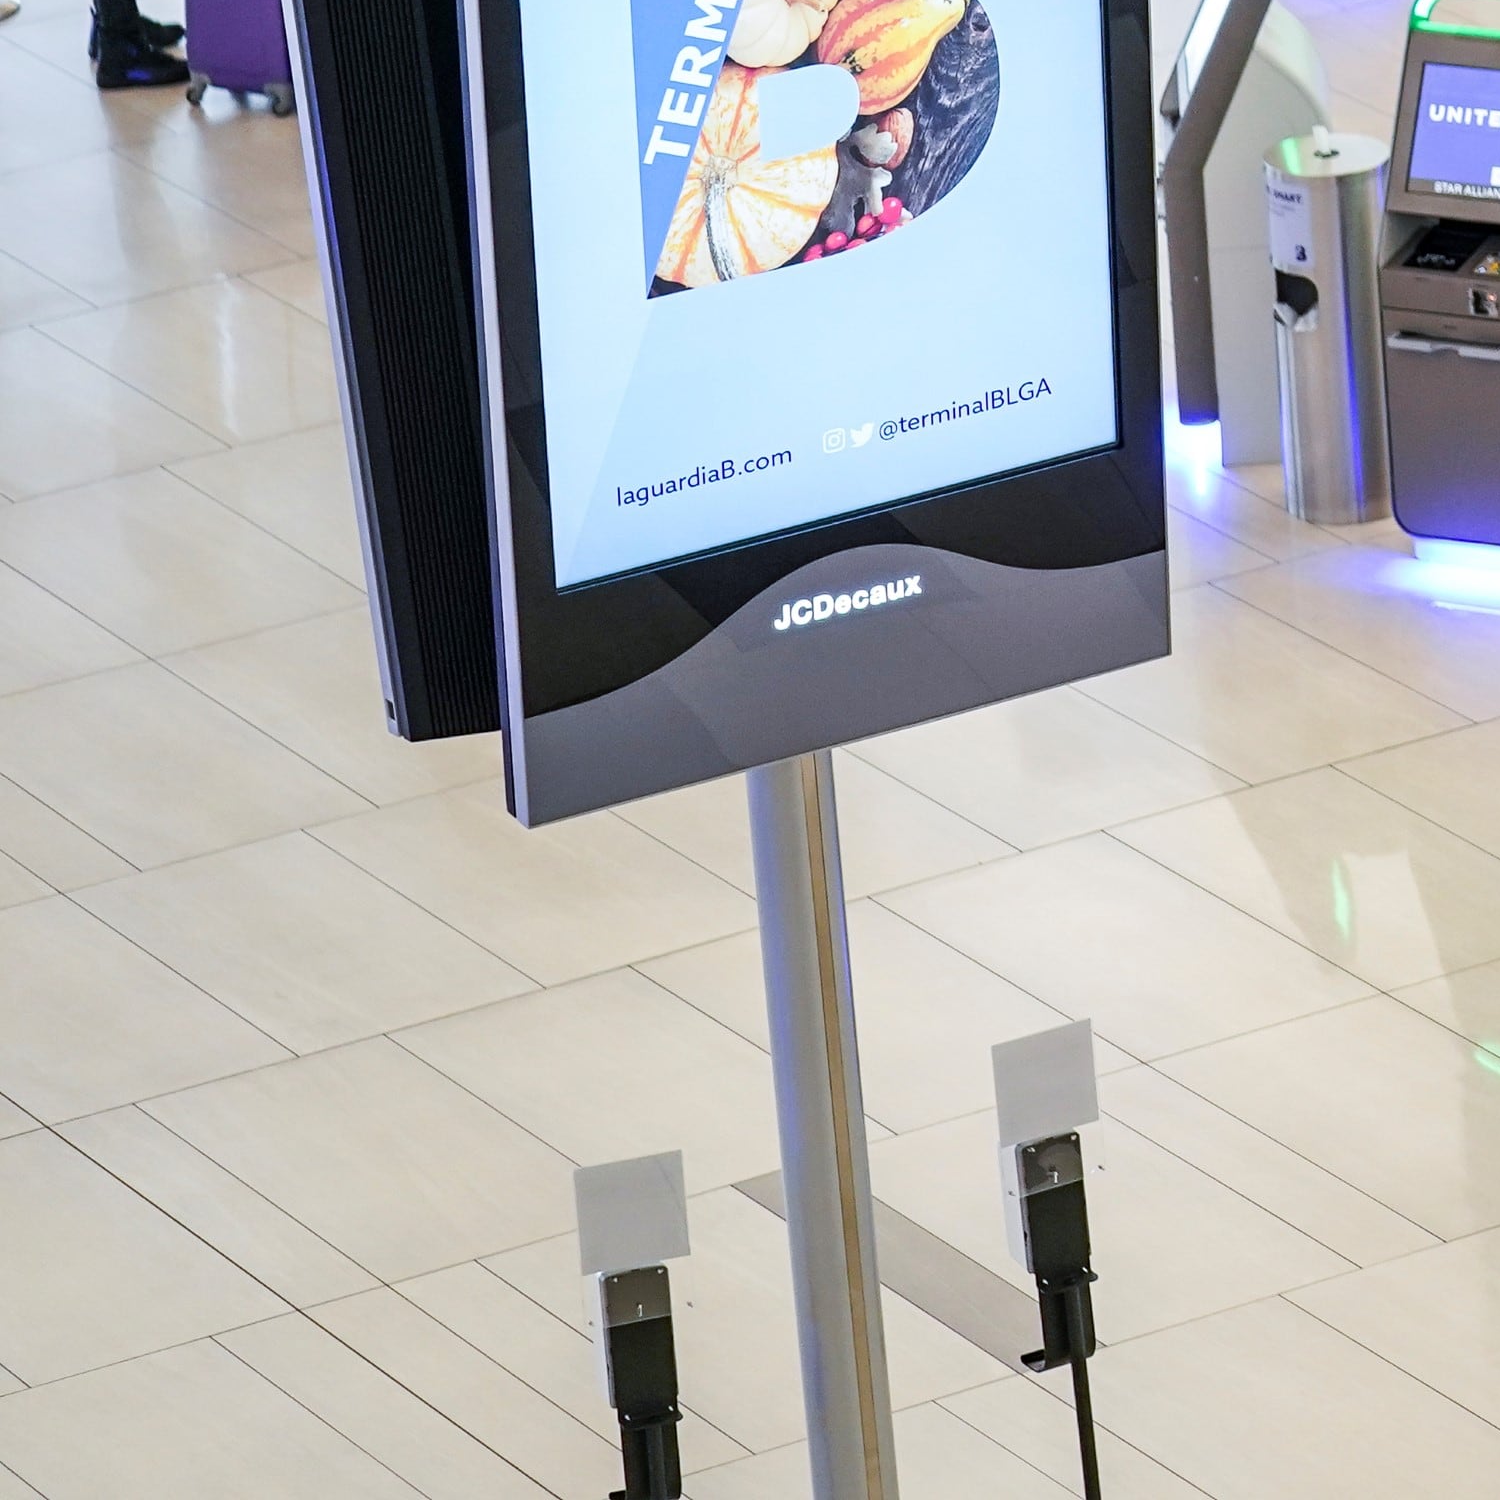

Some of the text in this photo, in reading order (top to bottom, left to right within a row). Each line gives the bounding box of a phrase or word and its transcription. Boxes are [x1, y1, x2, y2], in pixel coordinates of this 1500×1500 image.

[1434, 180, 1463, 196] STAR
[616, 376, 1053, 507] laguardiaB.com @terminalBLGA
[773, 574, 923, 631] JCDecaux
